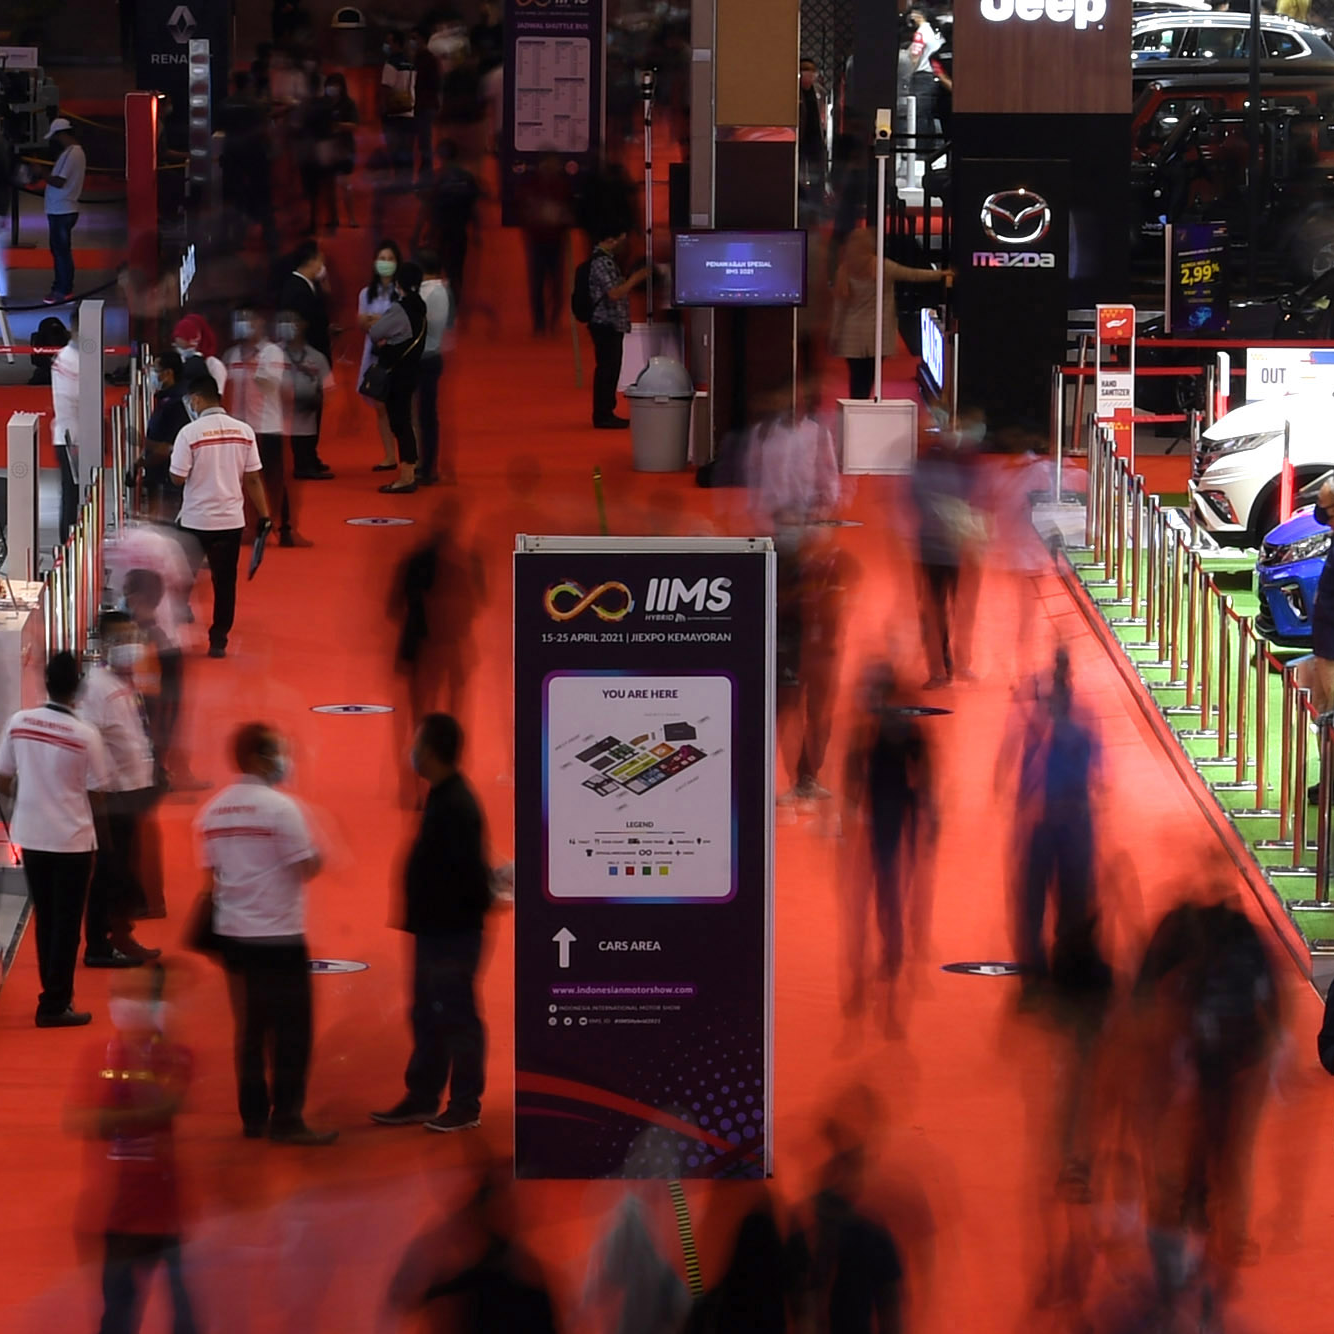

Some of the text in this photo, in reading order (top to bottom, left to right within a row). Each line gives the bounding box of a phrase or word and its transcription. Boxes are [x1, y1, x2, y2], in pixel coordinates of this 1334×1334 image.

[1261, 368, 1287, 384] OUT
[1101, 380, 1117, 388] HAND
[1101, 388, 1131, 397] SANITIZER
[644, 577, 733, 612] IIMS
[645, 614, 675, 622] HYBRID
[541, 633, 732, 642] 15-25 APRIL 2021 JIEXPO KEMAYORAN
[602, 689, 679, 699] YOU ARE HERE
[598, 941, 662, 951] CARS AREA
[552, 986, 694, 995] www.indonesianmotorshow.com
